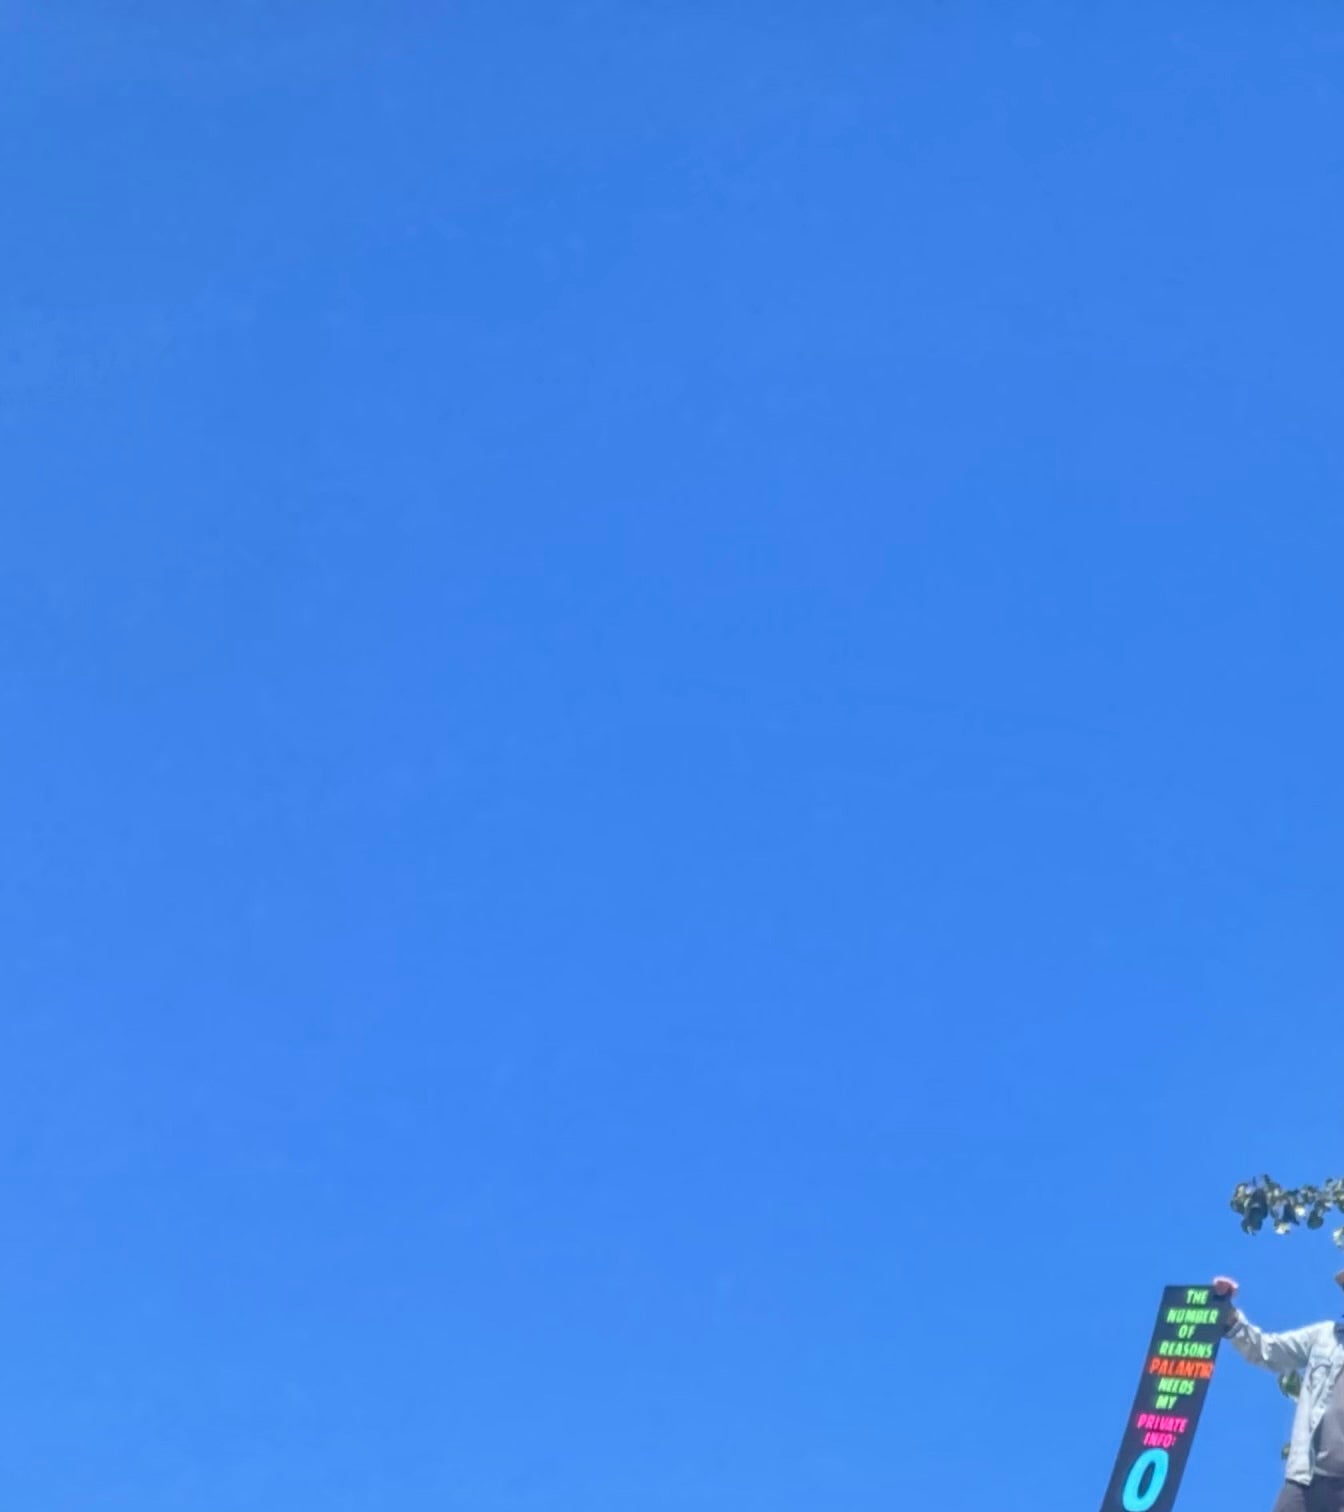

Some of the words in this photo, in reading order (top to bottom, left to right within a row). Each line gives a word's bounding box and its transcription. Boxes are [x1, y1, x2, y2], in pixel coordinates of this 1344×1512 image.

[1186, 1289, 1209, 1305] THE
[1166, 1308, 1219, 1324] NUMBER
[1178, 1325, 1196, 1339] OF
[1159, 1343, 1213, 1358] REASONS
[1148, 1359, 1214, 1379] PALANTIR
[1157, 1380, 1195, 1394] NEEDS
[1155, 1395, 1179, 1410] MY
[1136, 1414, 1189, 1433] PRIVATE
[1122, 1448, 1169, 1512] 0
